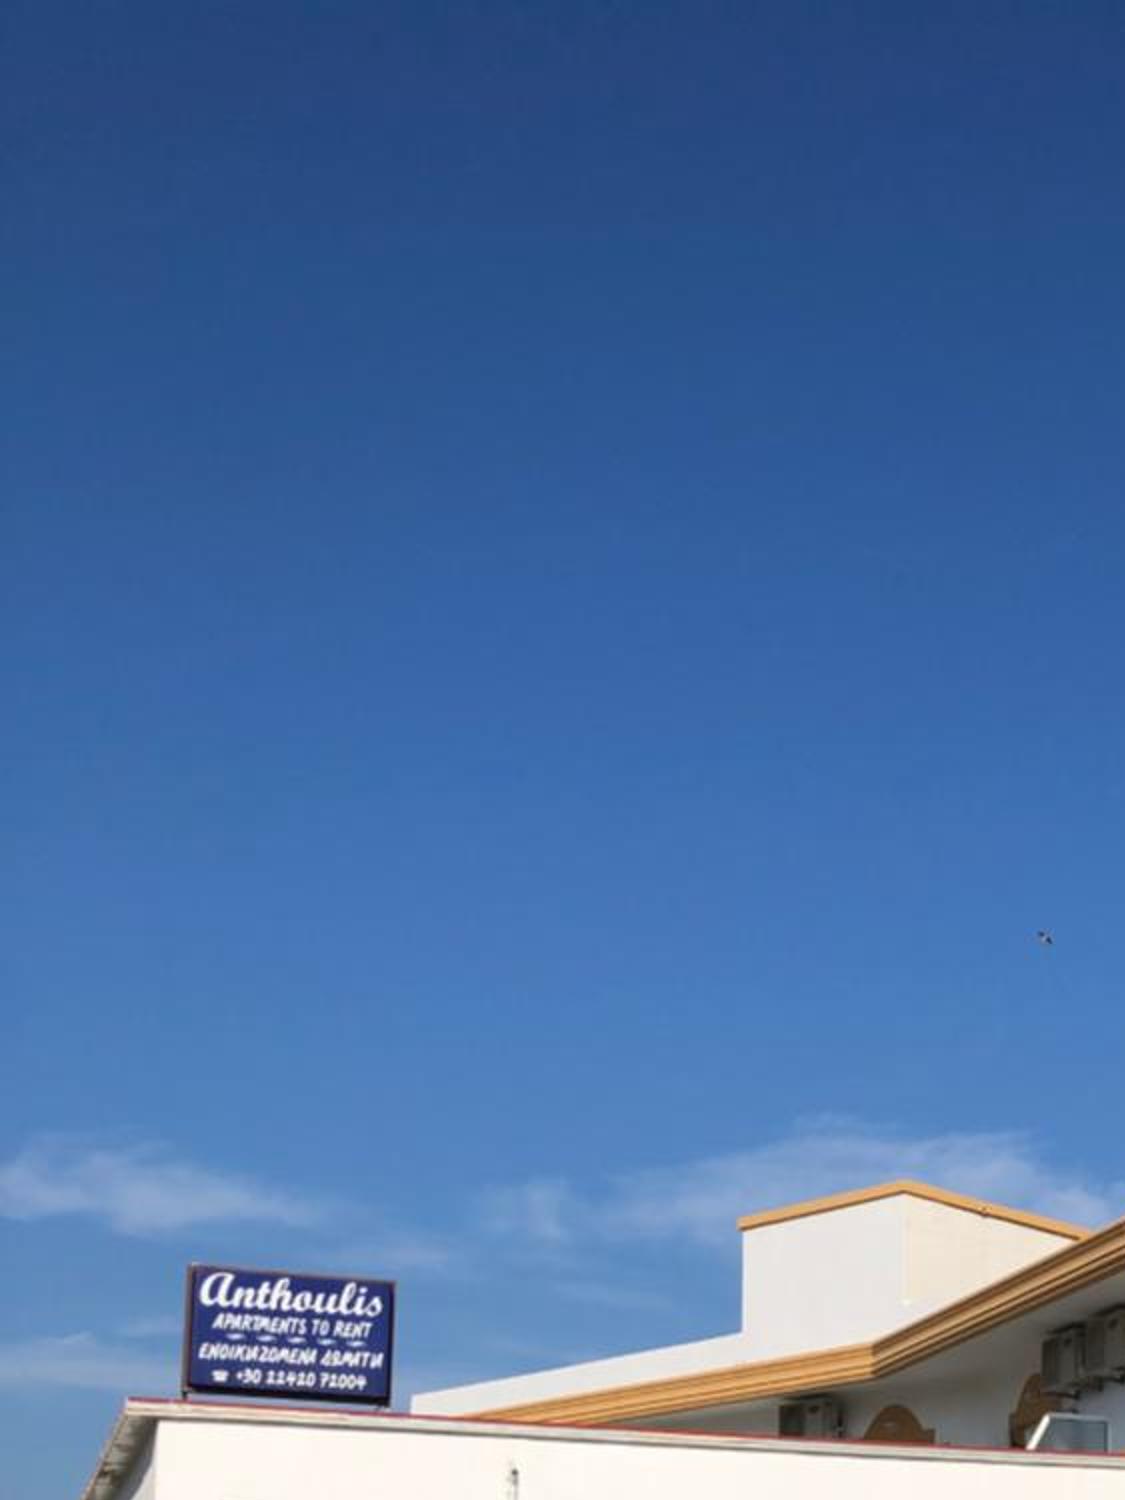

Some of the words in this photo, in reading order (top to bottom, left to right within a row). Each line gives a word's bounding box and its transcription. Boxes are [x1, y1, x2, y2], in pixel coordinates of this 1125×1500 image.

[200, 1272, 383, 1317] Anthoulis
[212, 1313, 307, 1334] APARTMENTS
[312, 1319, 329, 1336] TO
[333, 1321, 373, 1338] RENT
